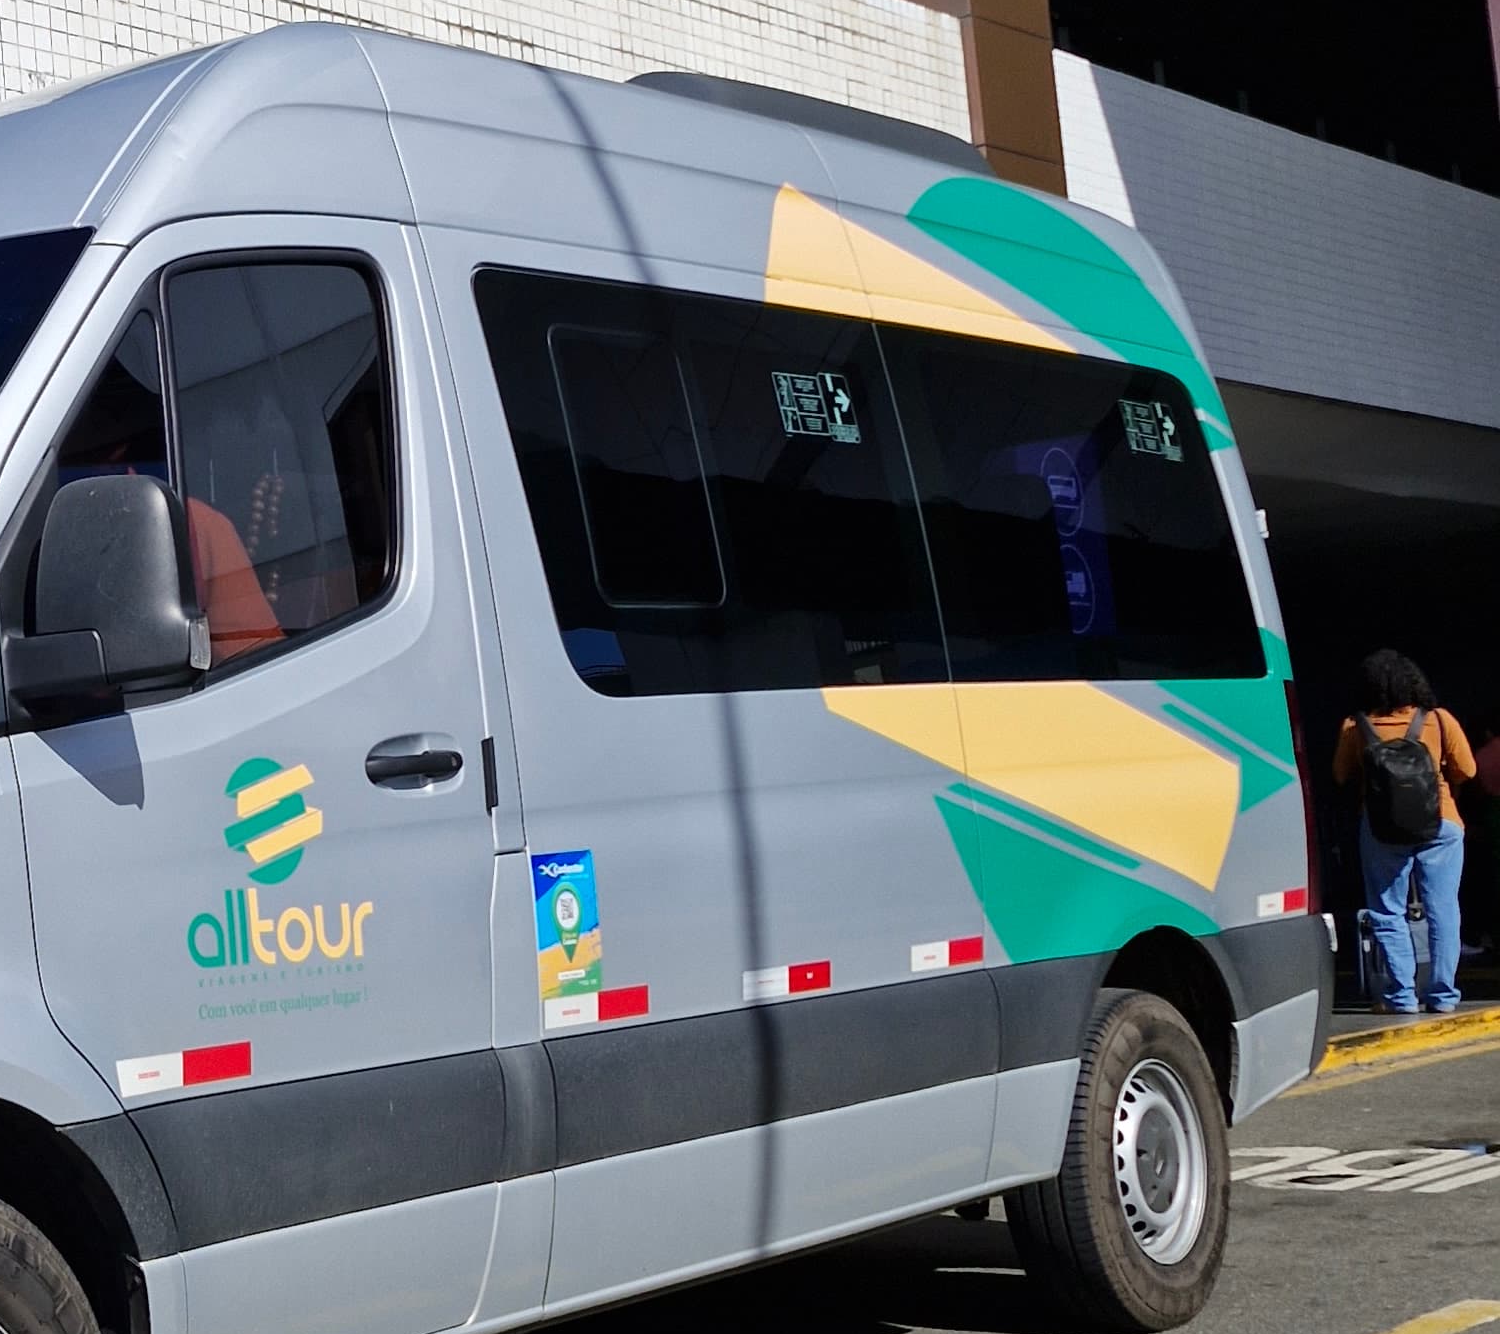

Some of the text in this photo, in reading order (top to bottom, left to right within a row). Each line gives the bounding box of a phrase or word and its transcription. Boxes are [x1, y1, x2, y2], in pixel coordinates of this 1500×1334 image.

[187, 887, 374, 969] alltour
[198, 1002, 228, 1020] Com
[229, 996, 258, 1017] você
[259, 999, 278, 1013] em
[279, 991, 331, 1015] qualquer
